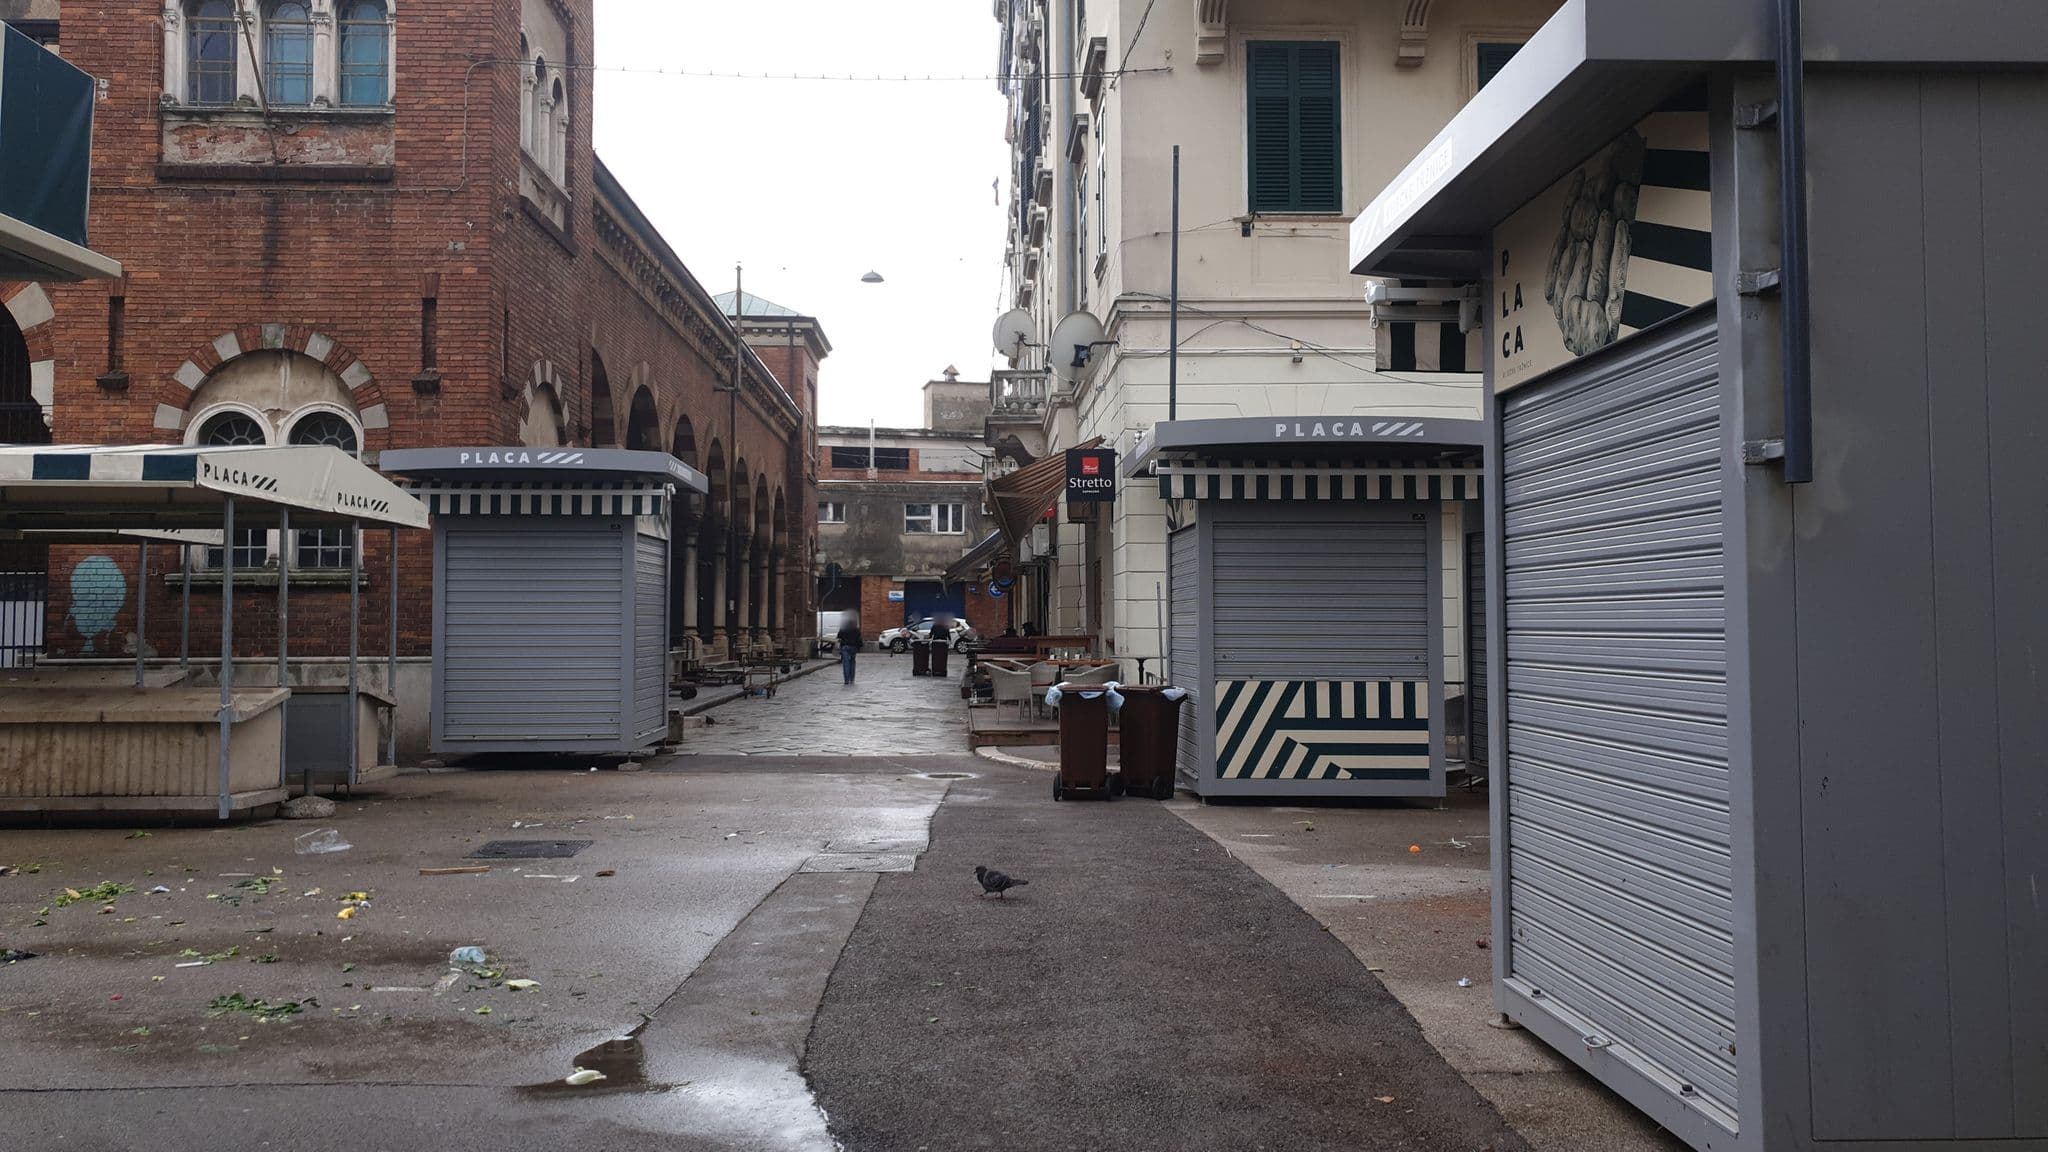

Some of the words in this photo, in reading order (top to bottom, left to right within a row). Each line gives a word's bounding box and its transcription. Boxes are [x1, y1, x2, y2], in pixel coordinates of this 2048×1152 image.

[1502, 249, 1510, 277] P
[1502, 283, 1524, 318] LA
[1502, 325, 1524, 358] CA
[1275, 422, 1364, 437] PLACA
[460, 452, 530, 464] PLACA
[203, 463, 248, 487] PLACA
[1069, 477, 1112, 488] Stretto
[337, 492, 368, 508] PLACA
